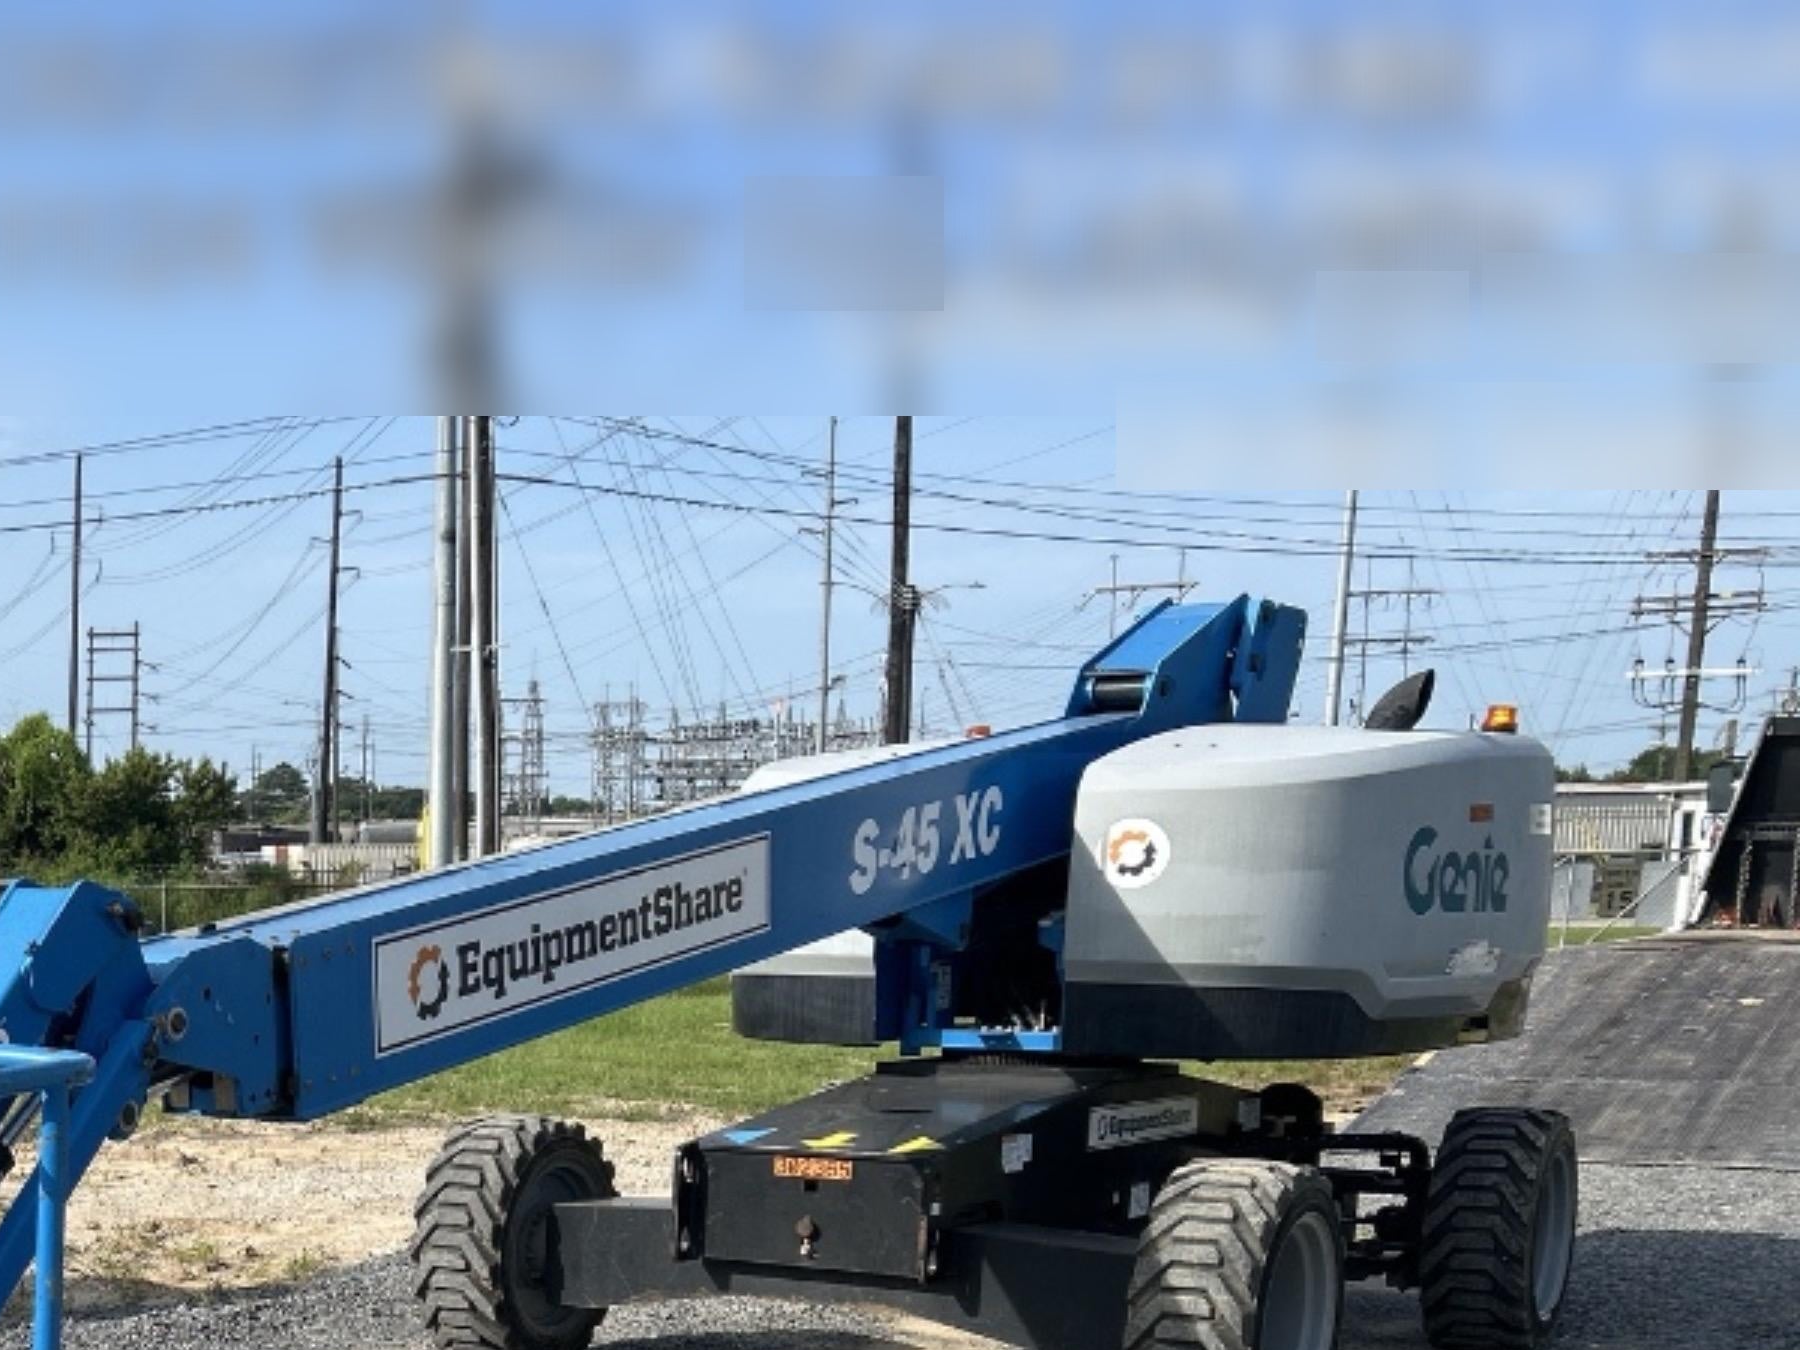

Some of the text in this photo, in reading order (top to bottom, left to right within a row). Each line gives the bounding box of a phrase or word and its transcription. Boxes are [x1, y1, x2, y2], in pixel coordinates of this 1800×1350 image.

[849, 785, 1003, 895] S-45 XC
[1403, 825, 1511, 915] Genie
[456, 876, 742, 998] EquipmentShare
